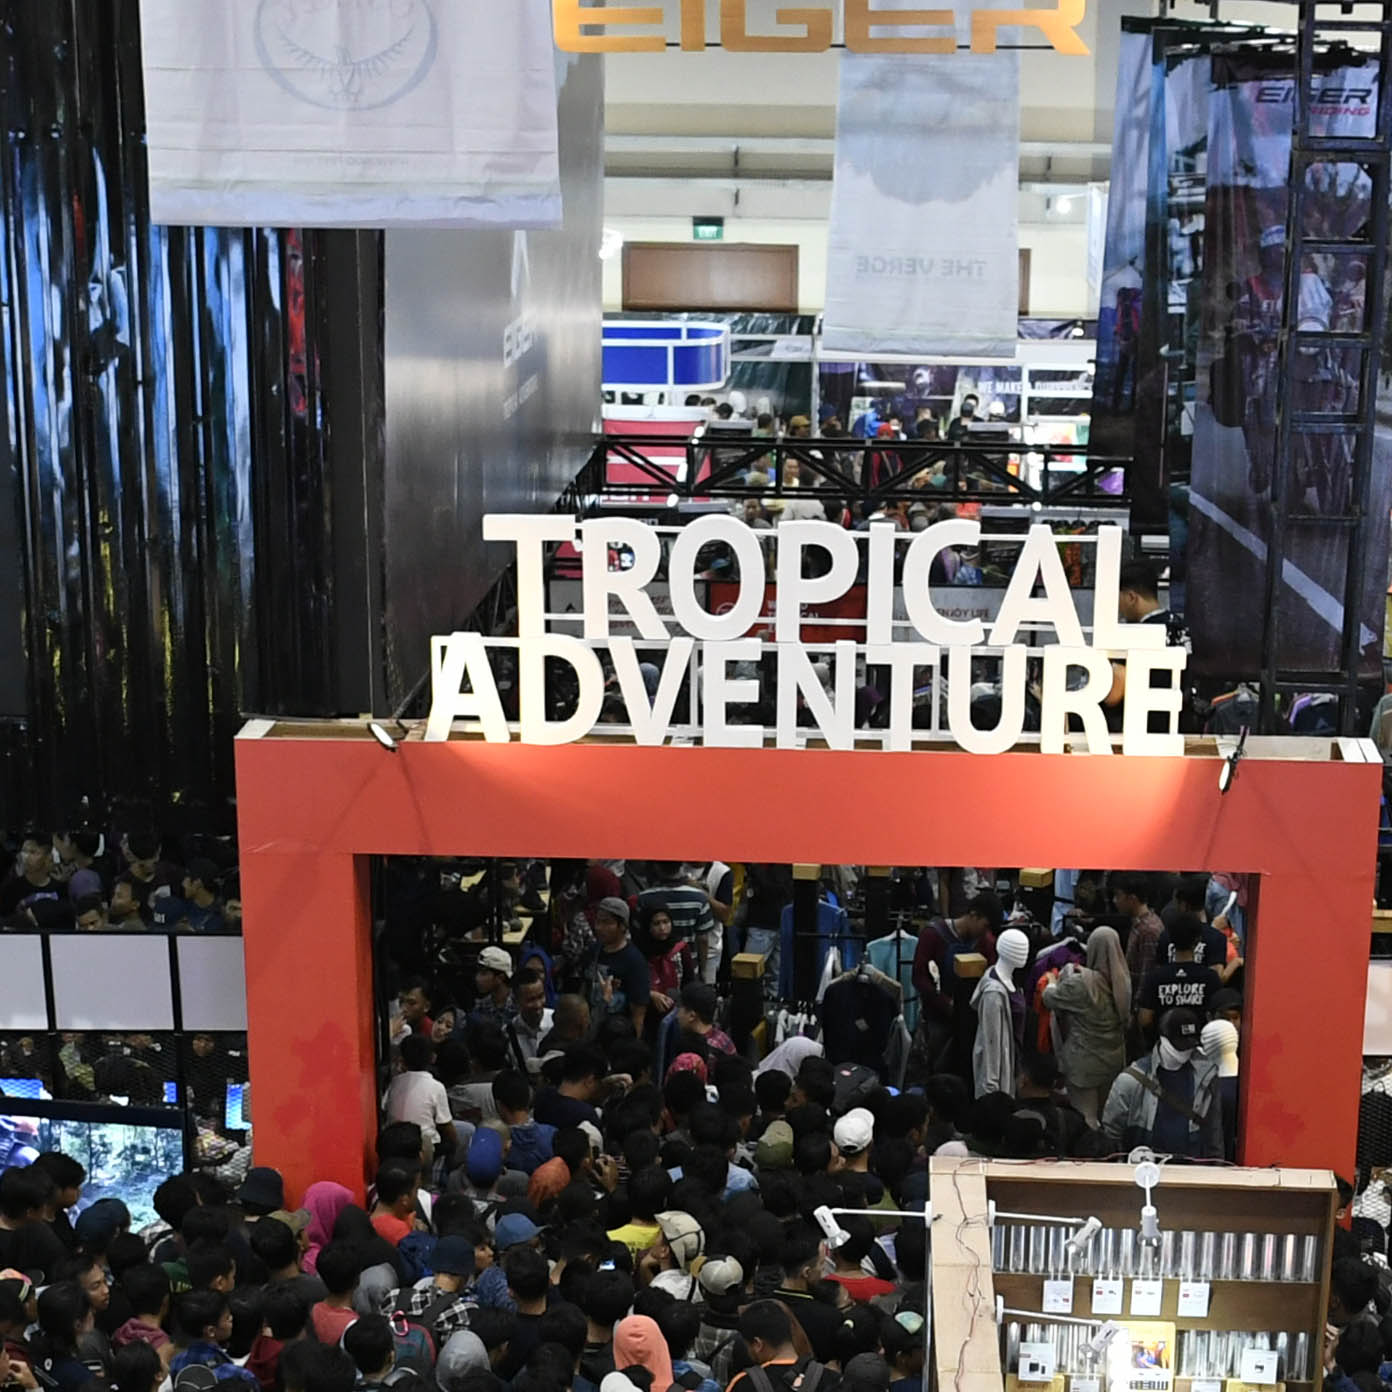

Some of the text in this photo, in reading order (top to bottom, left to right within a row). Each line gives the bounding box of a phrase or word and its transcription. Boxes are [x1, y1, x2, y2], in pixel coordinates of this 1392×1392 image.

[553, 0, 1091, 55] EIGER
[1254, 86, 1373, 105] EIER
[482, 513, 1166, 648] TROPICAL
[425, 631, 1187, 757] ADVENTURE
[1158, 982, 1206, 997] EXPLORE
